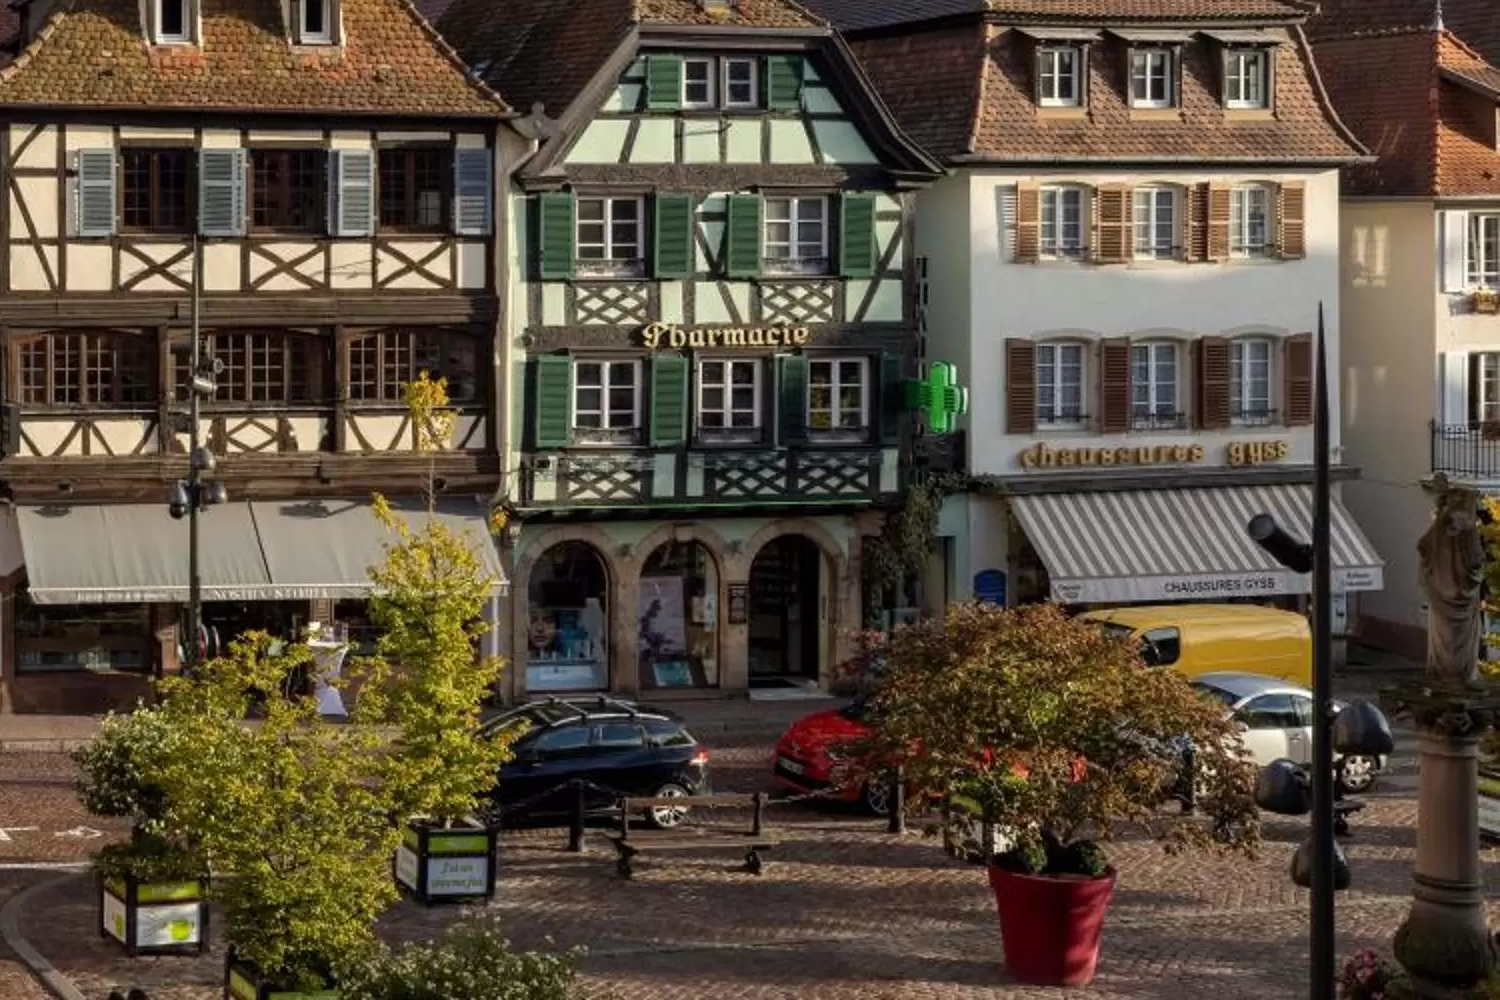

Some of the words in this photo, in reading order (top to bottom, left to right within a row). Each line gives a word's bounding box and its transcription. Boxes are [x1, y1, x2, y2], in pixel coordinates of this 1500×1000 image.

[642, 321, 810, 347] Pharmacie
[1019, 442, 1204, 468] chaussures
[1227, 439, 1290, 468] gyss
[1164, 579, 1241, 593] CHAUSSURES
[1243, 577, 1276, 590] GYSS
